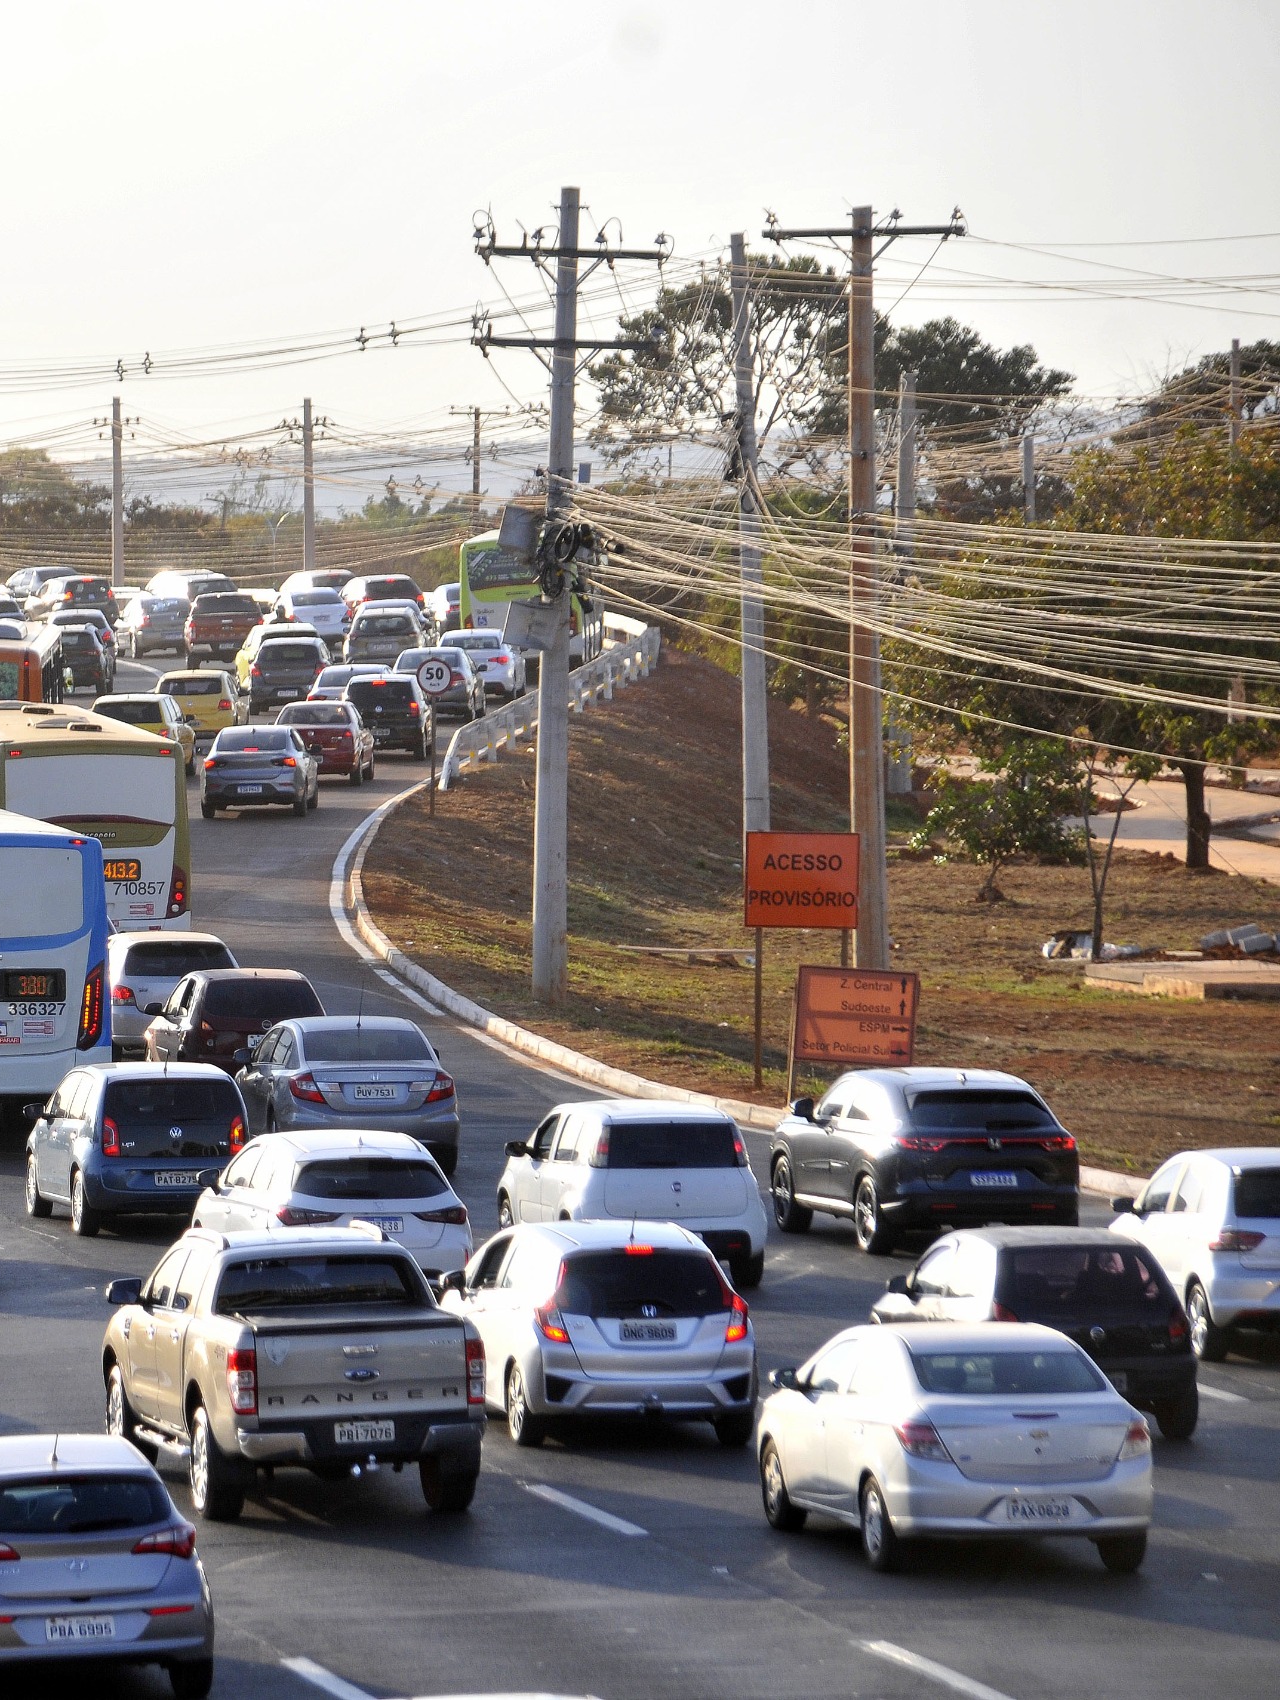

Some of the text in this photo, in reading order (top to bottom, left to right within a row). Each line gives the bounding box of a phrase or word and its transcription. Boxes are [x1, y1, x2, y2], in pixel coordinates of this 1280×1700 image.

[425, 666, 444, 680] 50
[103, 861, 139, 879] 413.2
[763, 853, 843, 872] ACESSO
[113, 881, 166, 896] 710857
[748, 887, 856, 908] PROVISÓRIO
[853, 979, 893, 992] Central
[8, 1002, 67, 1016] 336327
[841, 1000, 891, 1014] Sudoeste
[859, 1021, 890, 1033] ESPM
[802, 1040, 829, 1052] Setor
[833, 1041, 871, 1055] Policial
[267, 1385, 459, 1405] RANGER
